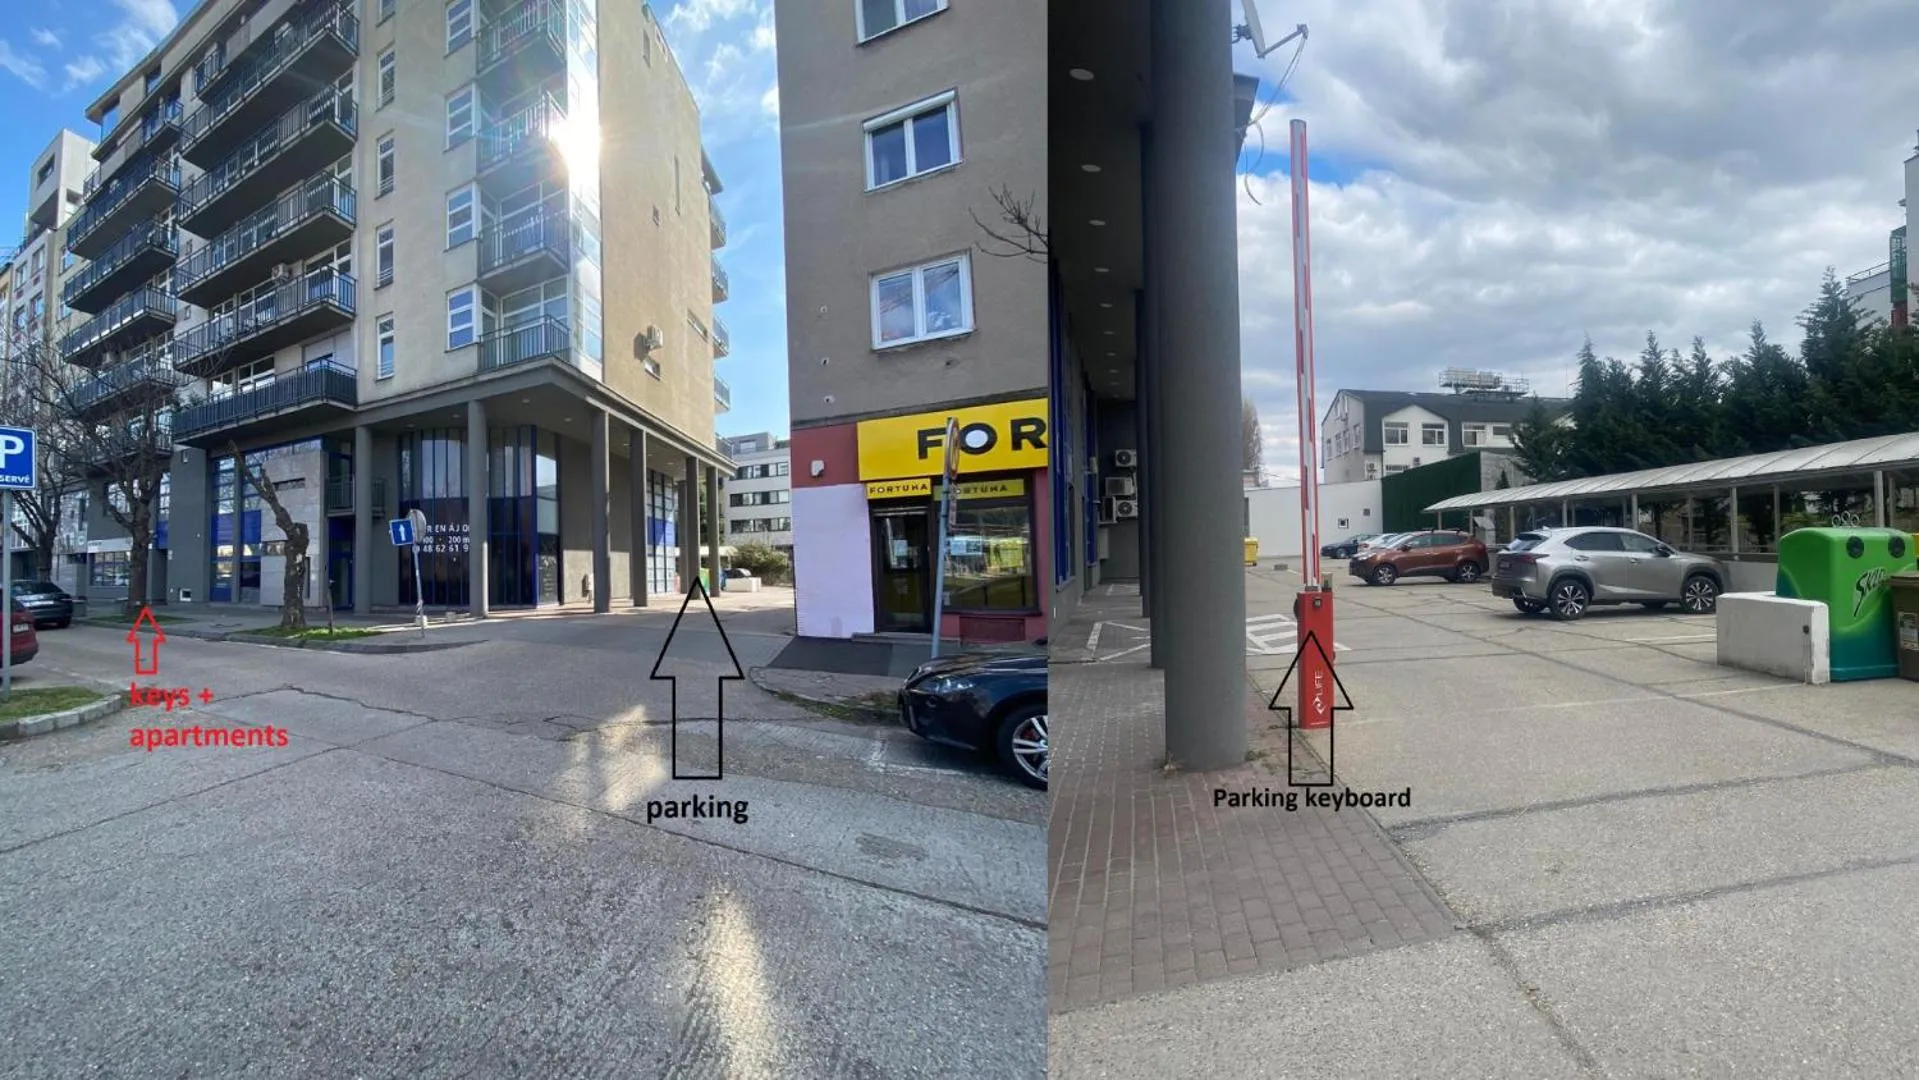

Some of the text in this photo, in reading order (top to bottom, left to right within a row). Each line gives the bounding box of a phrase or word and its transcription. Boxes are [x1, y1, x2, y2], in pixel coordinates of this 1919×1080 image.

[0, 435, 25, 469] P
[917, 417, 1047, 459] FOR
[869, 483, 928, 494] FORTUNA
